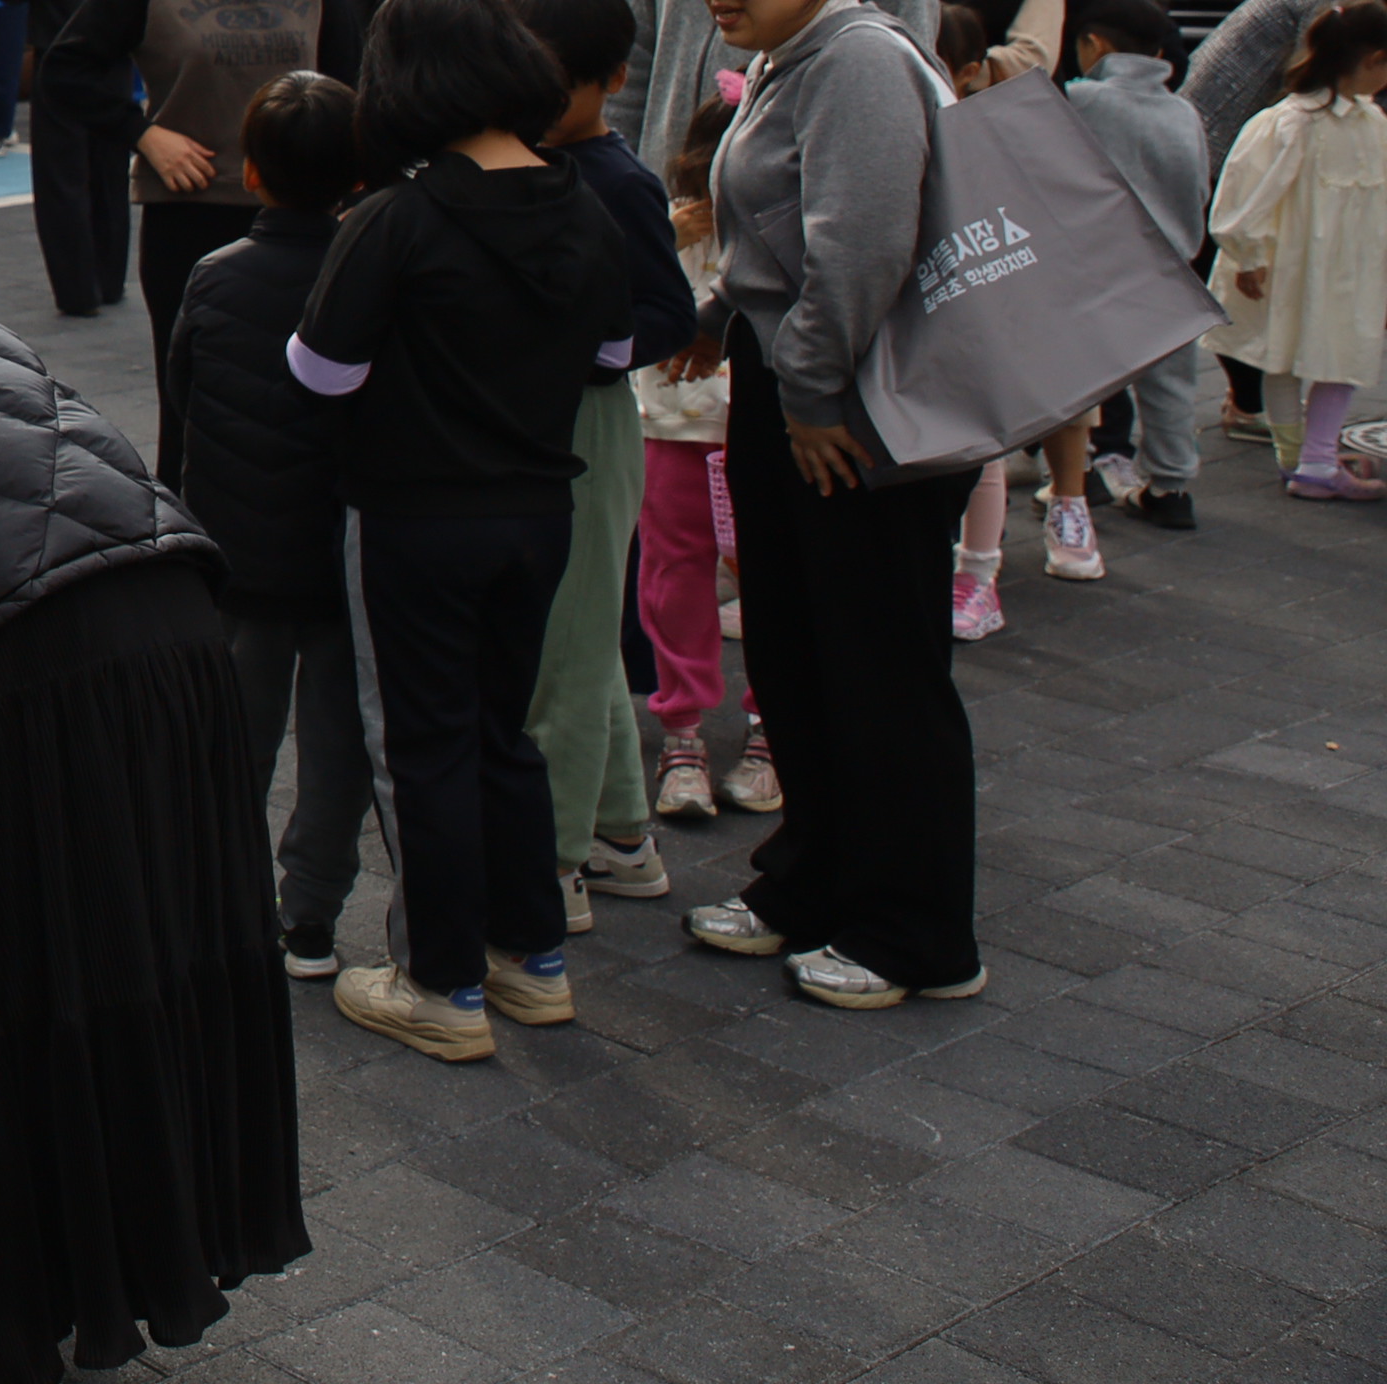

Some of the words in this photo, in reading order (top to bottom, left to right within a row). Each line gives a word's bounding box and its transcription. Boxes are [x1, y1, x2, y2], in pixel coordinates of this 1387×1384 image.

[916, 218, 1000, 293] 알뜰시장
[922, 277, 967, 314] 칠곡초
[963, 246, 1039, 287] 학생자치회
